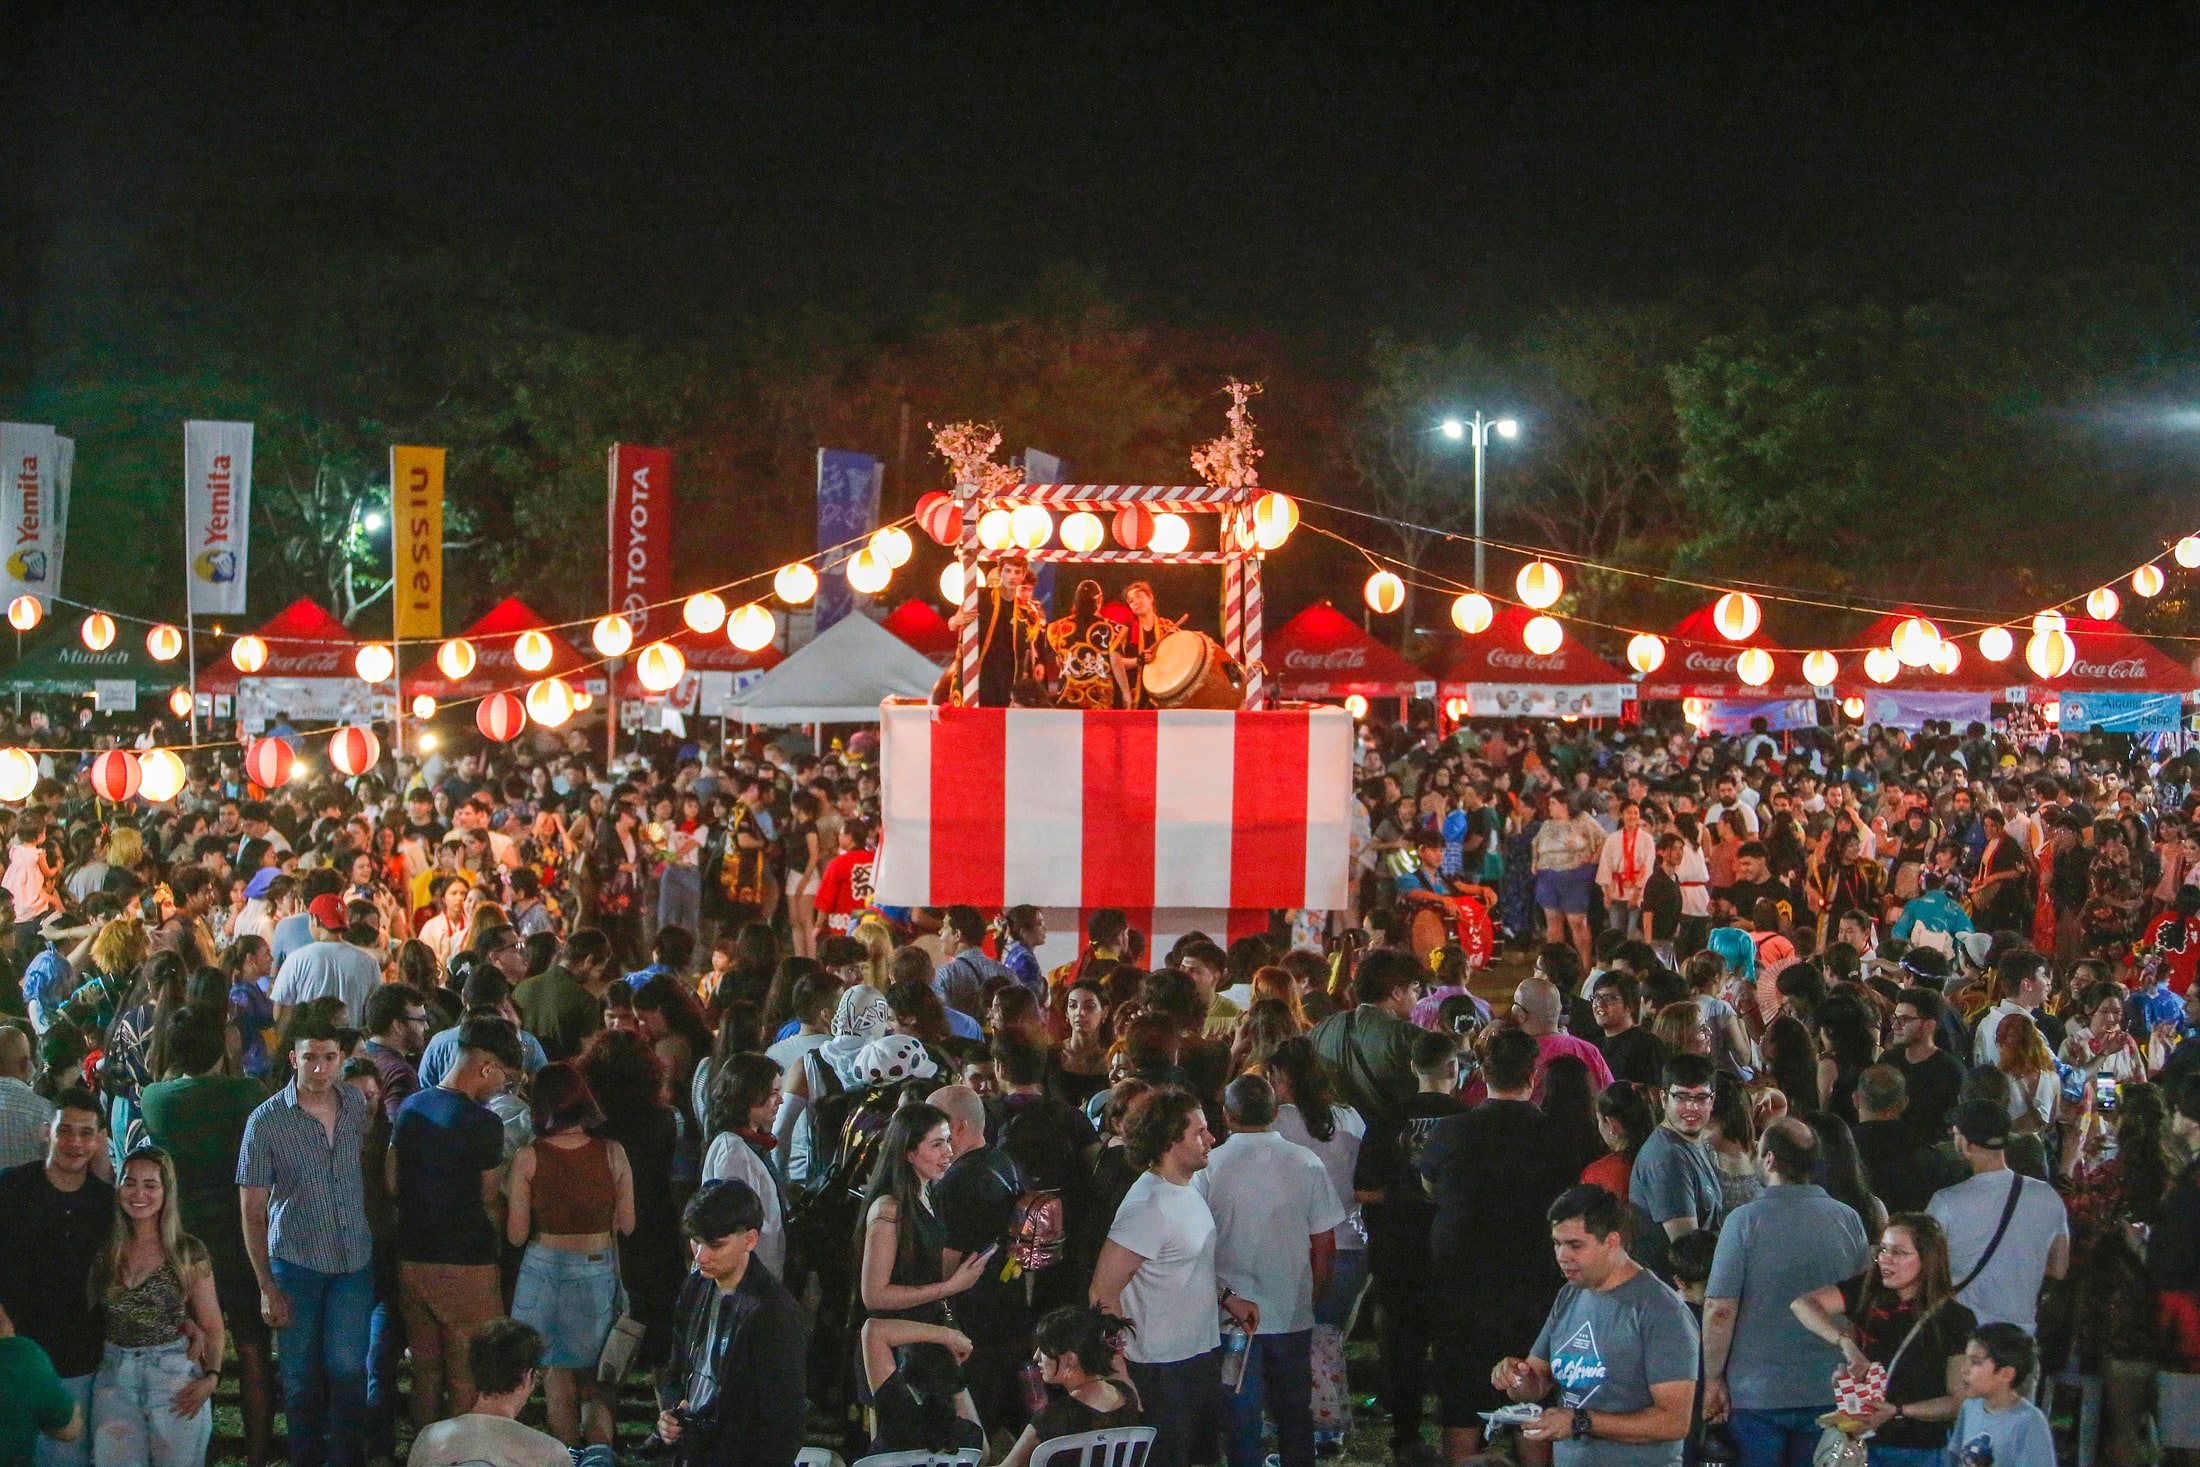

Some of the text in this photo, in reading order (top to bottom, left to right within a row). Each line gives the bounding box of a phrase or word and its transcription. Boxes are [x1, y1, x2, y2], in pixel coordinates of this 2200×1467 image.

[17, 456, 40, 545] Yemita
[204, 454, 231, 546] Yemita
[626, 466, 650, 589] TOYOTA
[58, 648, 130, 664] Munich
[2072, 658, 2147, 679] Coca-Cola
[2011, 690, 2021, 698] 17
